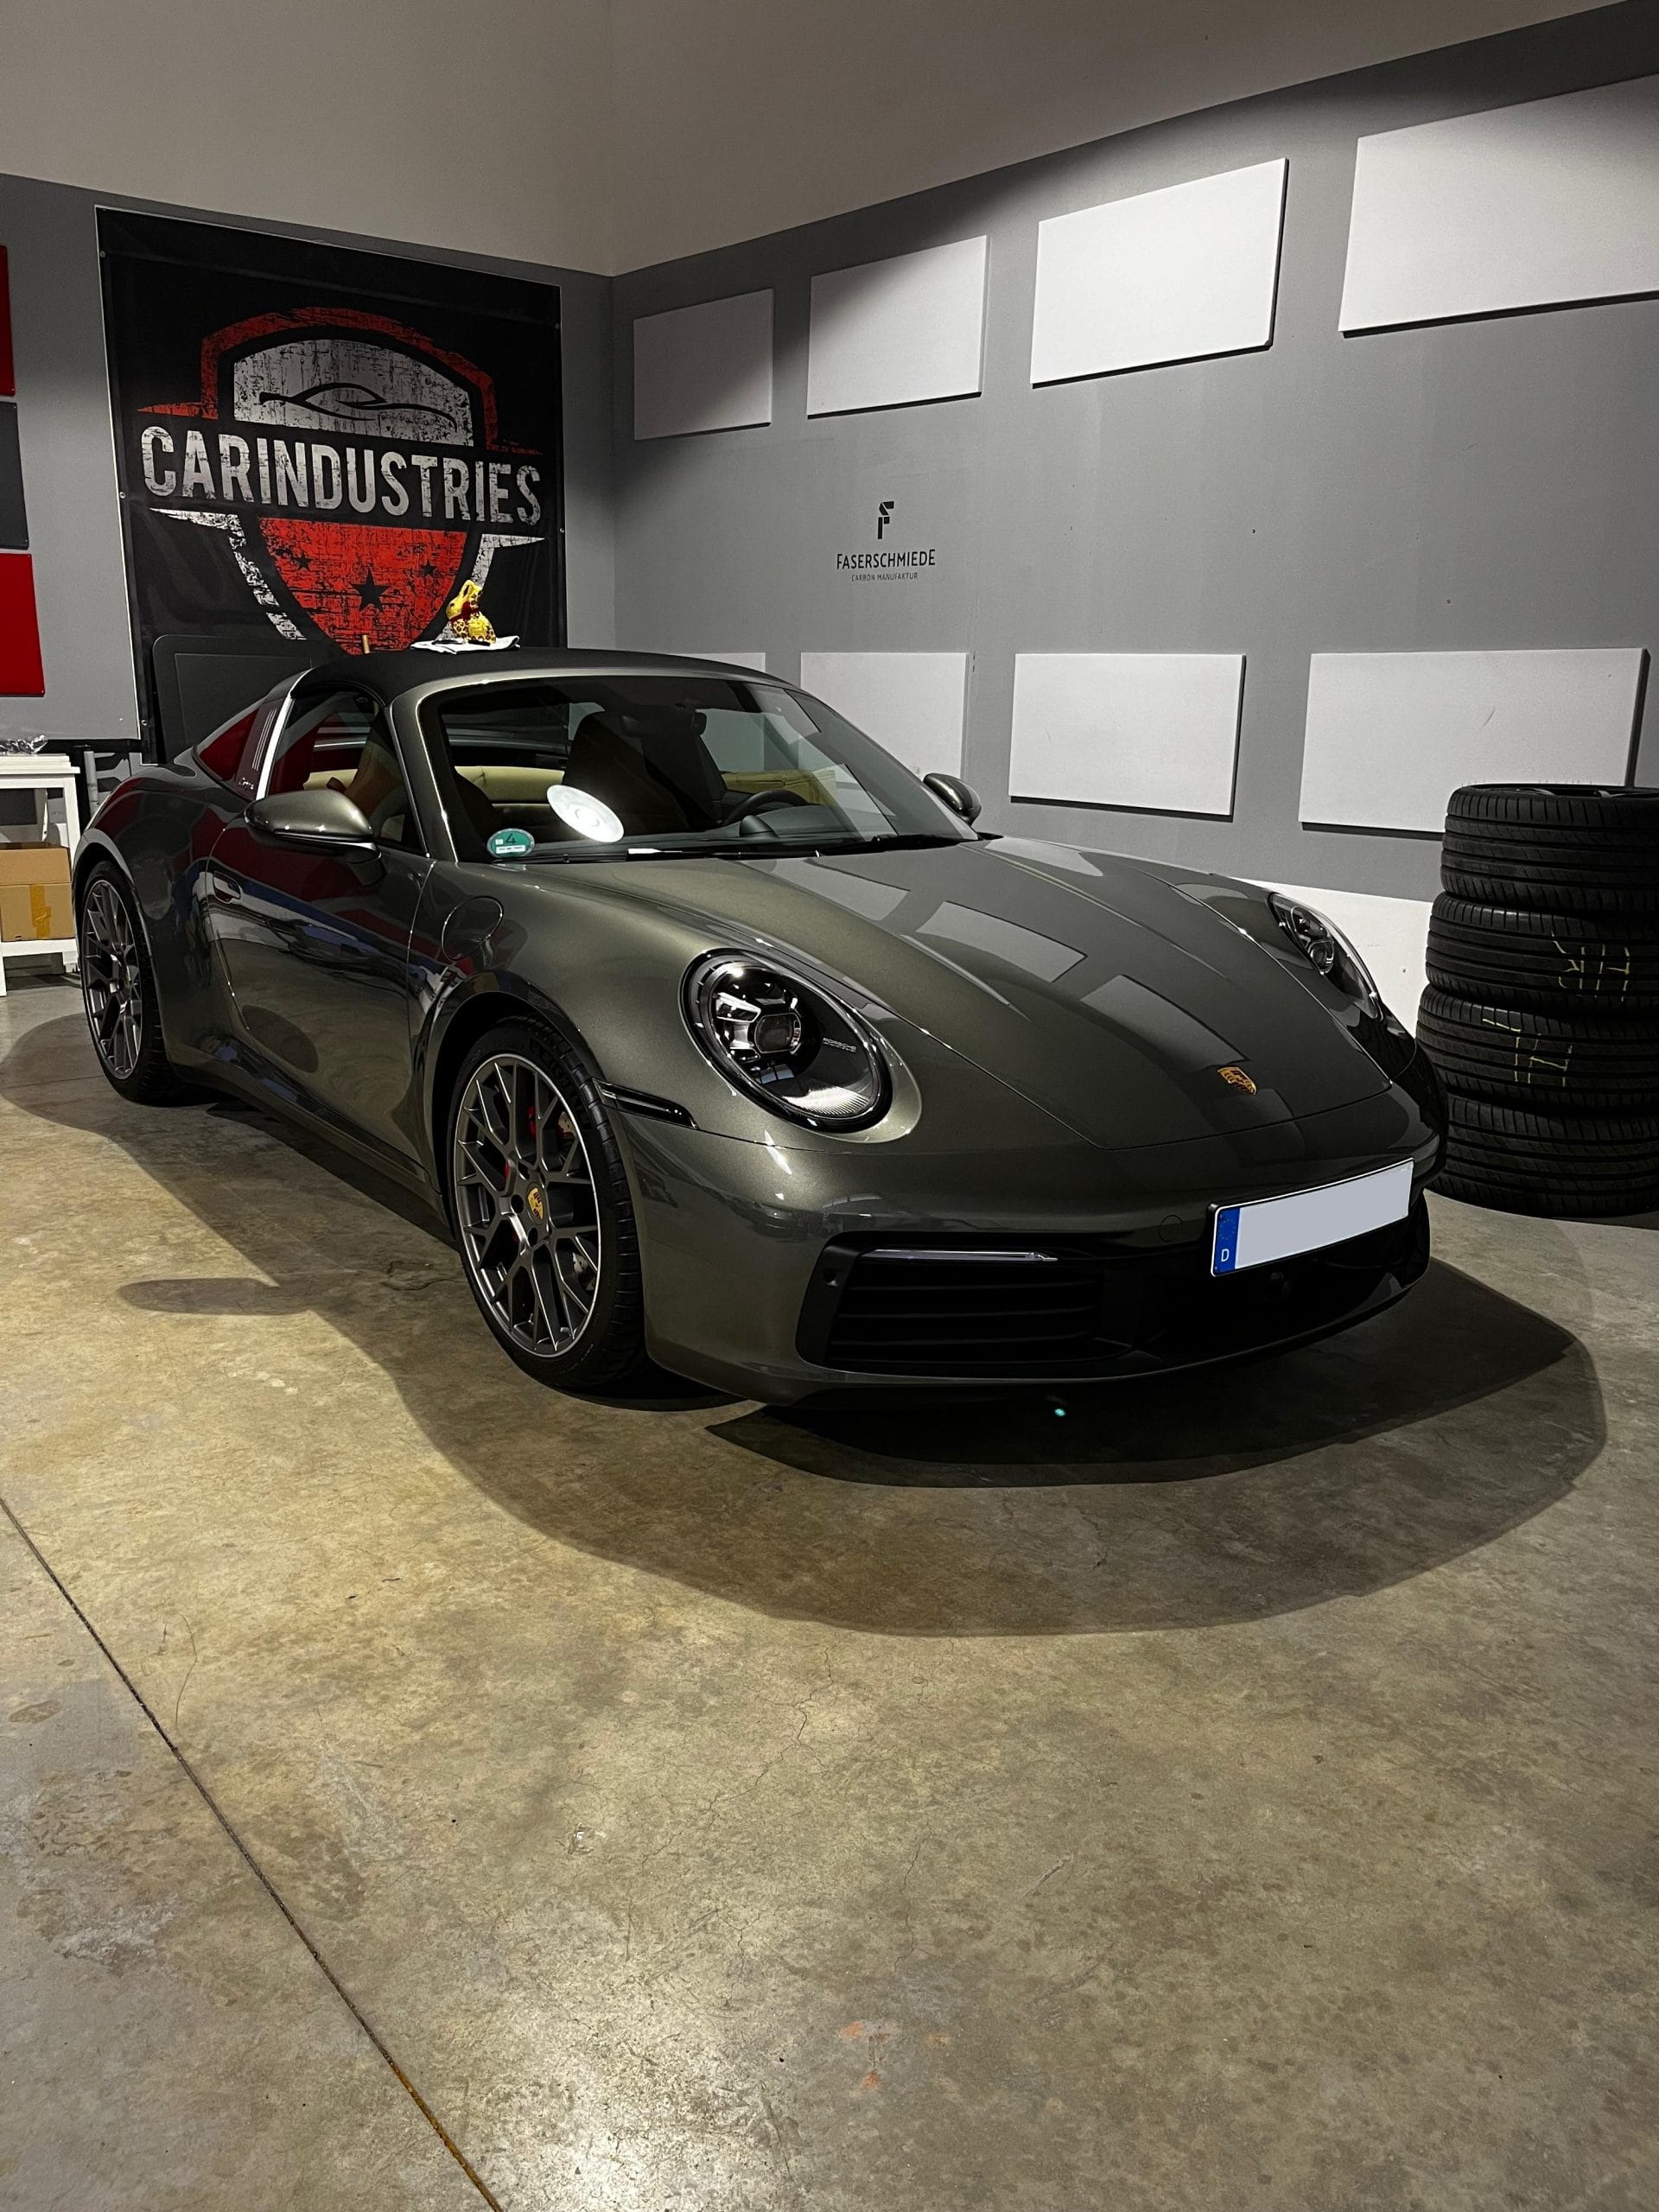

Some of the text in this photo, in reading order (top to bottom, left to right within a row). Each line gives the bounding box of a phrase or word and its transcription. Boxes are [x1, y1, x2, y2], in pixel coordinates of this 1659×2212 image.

[142, 426, 542, 524] CARINDUSTRIES
[836, 549, 936, 569] FASERSCHMIEDE
[851, 572, 918, 582] CARBON MANUFAKTUR
[505, 833, 516, 844] 4
[1221, 1249, 1230, 1262] D
